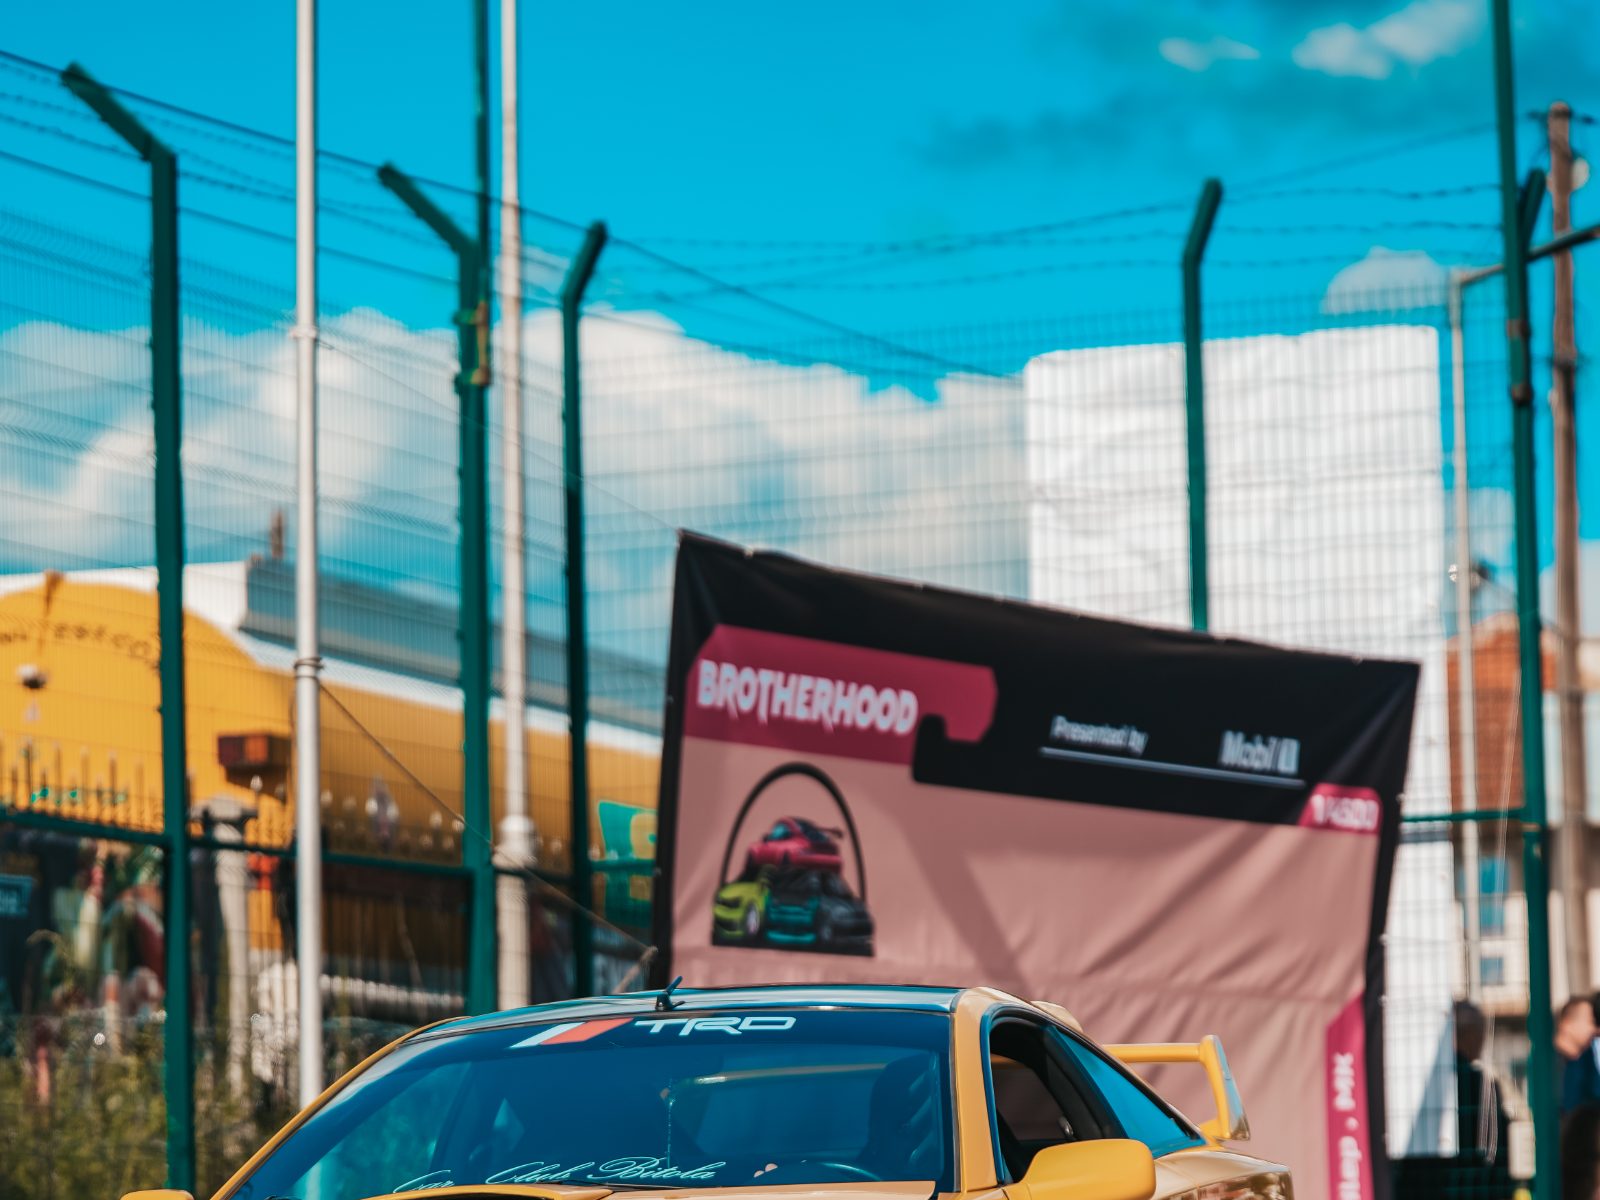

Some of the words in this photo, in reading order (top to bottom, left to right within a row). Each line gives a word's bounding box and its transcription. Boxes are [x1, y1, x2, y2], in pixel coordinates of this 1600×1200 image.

[698, 659, 918, 734] BROTHERHOOD
[1051, 715, 1129, 748] Presented
[634, 1016, 797, 1036] TRD
[486, 1161, 596, 1184] Club
[587, 1157, 726, 1180] Bitola
